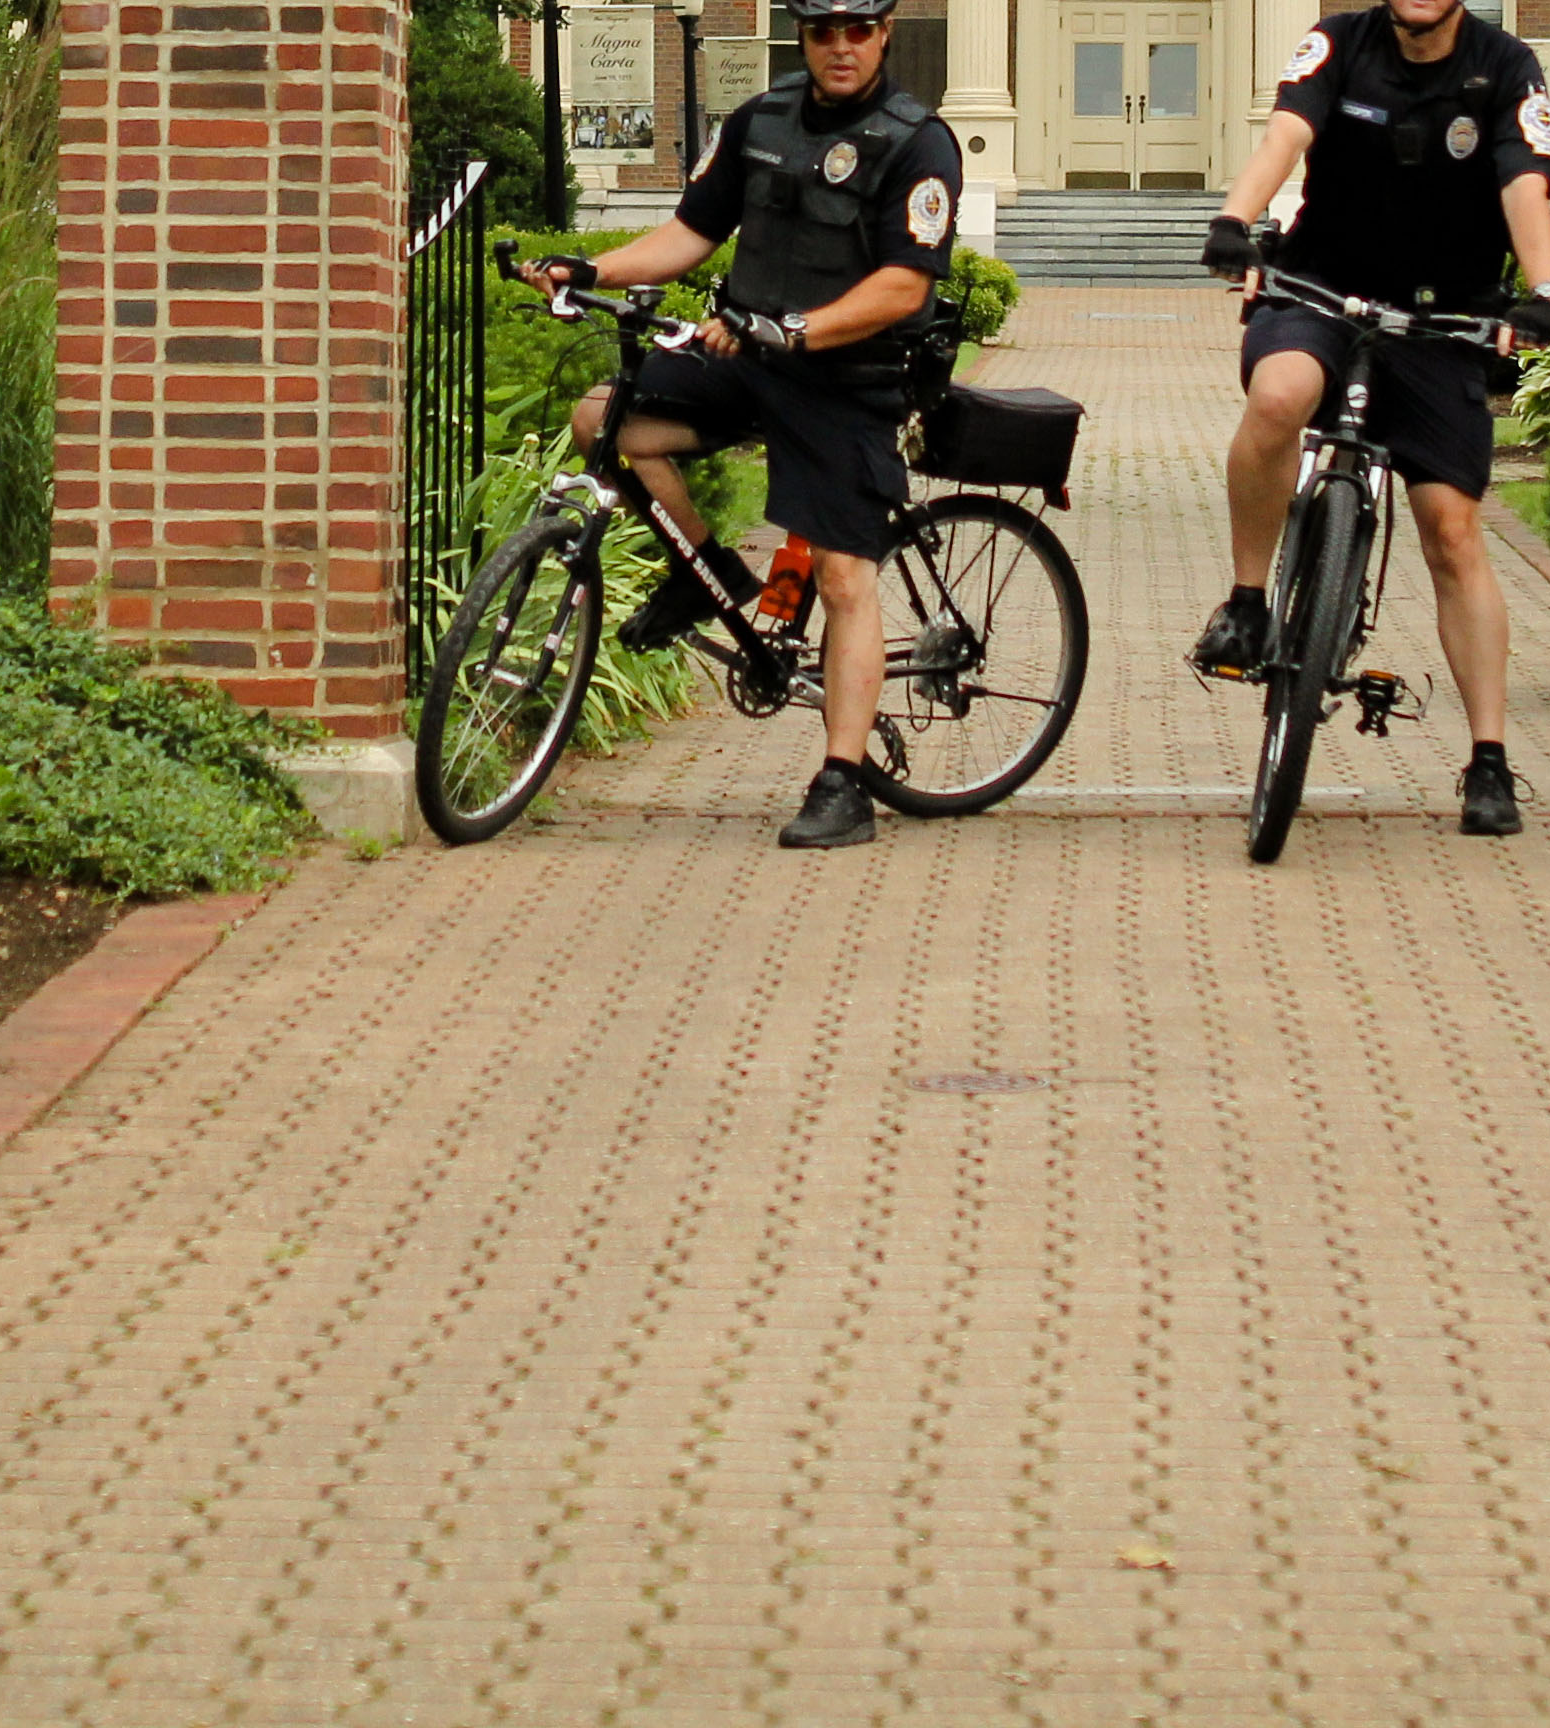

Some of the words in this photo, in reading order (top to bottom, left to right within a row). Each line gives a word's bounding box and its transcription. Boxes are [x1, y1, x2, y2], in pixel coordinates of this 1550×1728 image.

[580, 32, 643, 54] Magna
[590, 53, 636, 69] Carta
[711, 58, 759, 73] Magna
[719, 74, 754, 85] Carta
[650, 500, 696, 559] CAMPUS
[692, 556, 735, 610] SAFETY
